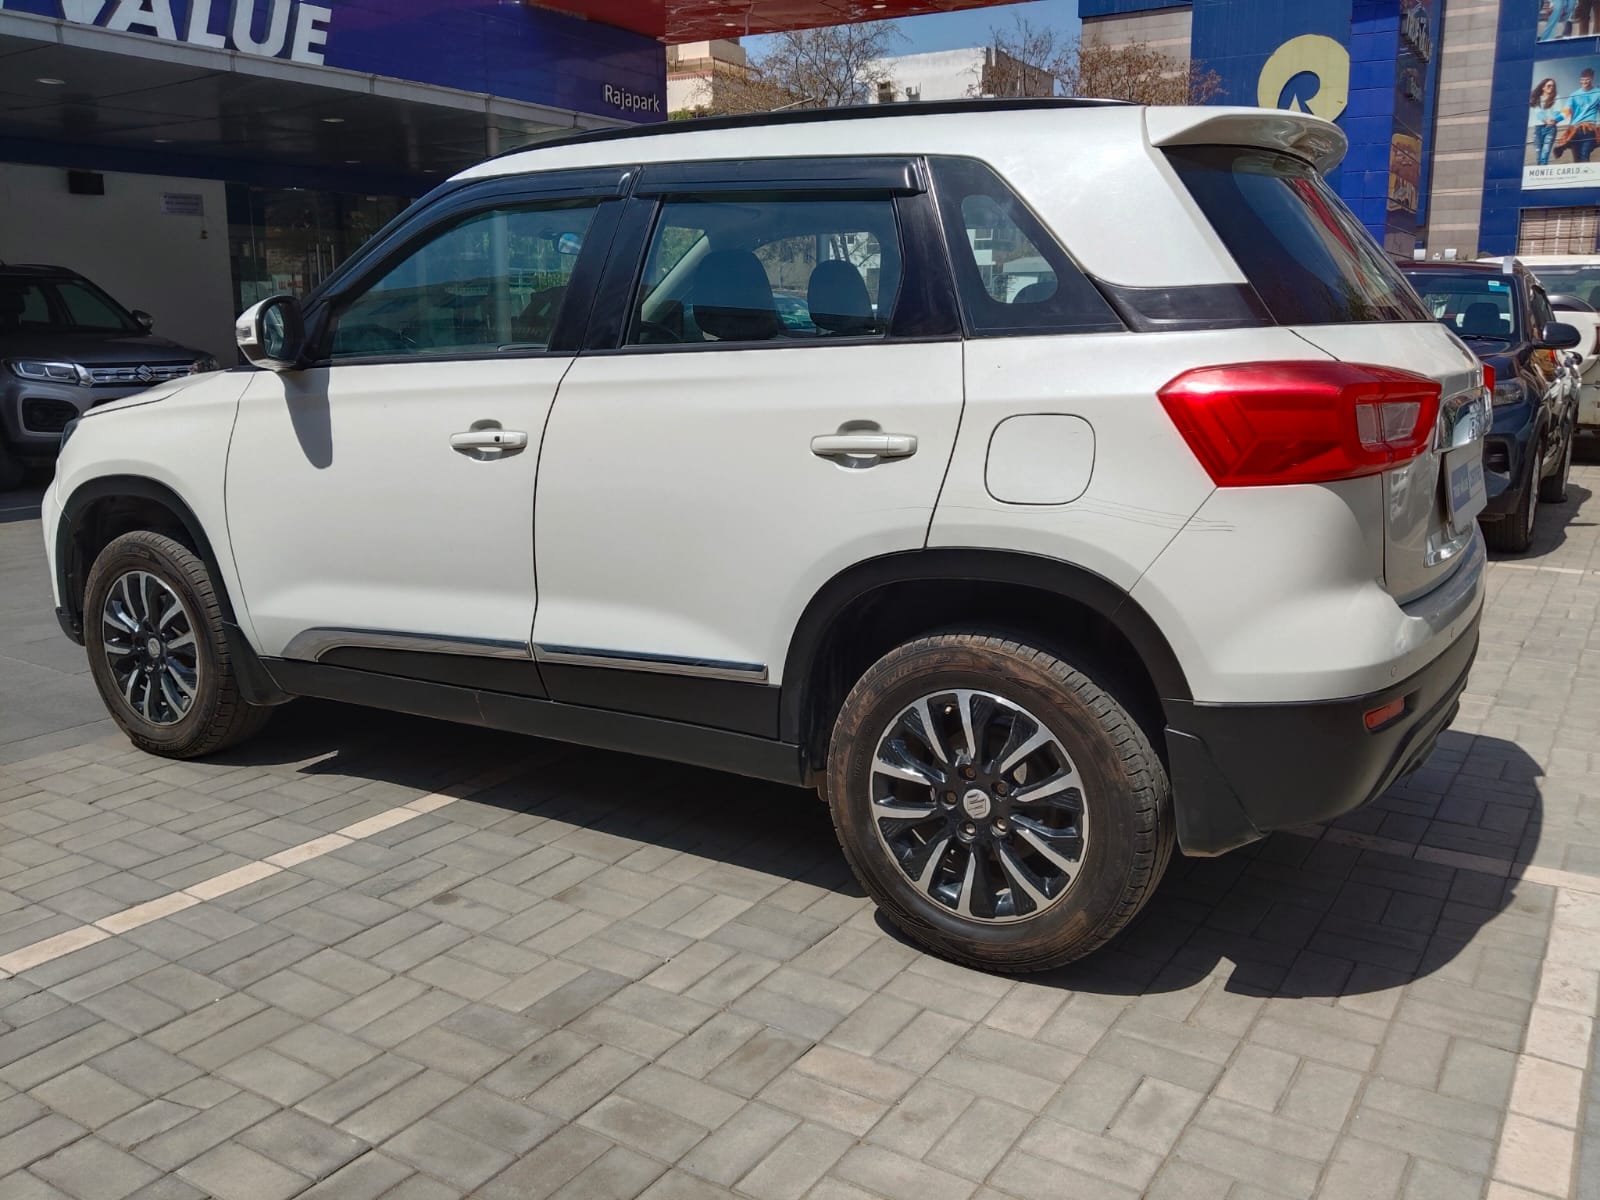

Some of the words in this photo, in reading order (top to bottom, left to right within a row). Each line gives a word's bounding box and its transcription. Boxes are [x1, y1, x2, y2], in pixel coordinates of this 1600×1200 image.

[604, 84, 661, 113] Rajapark
[1528, 168, 1554, 177] MONTE
[1556, 167, 1581, 176] CARLO
